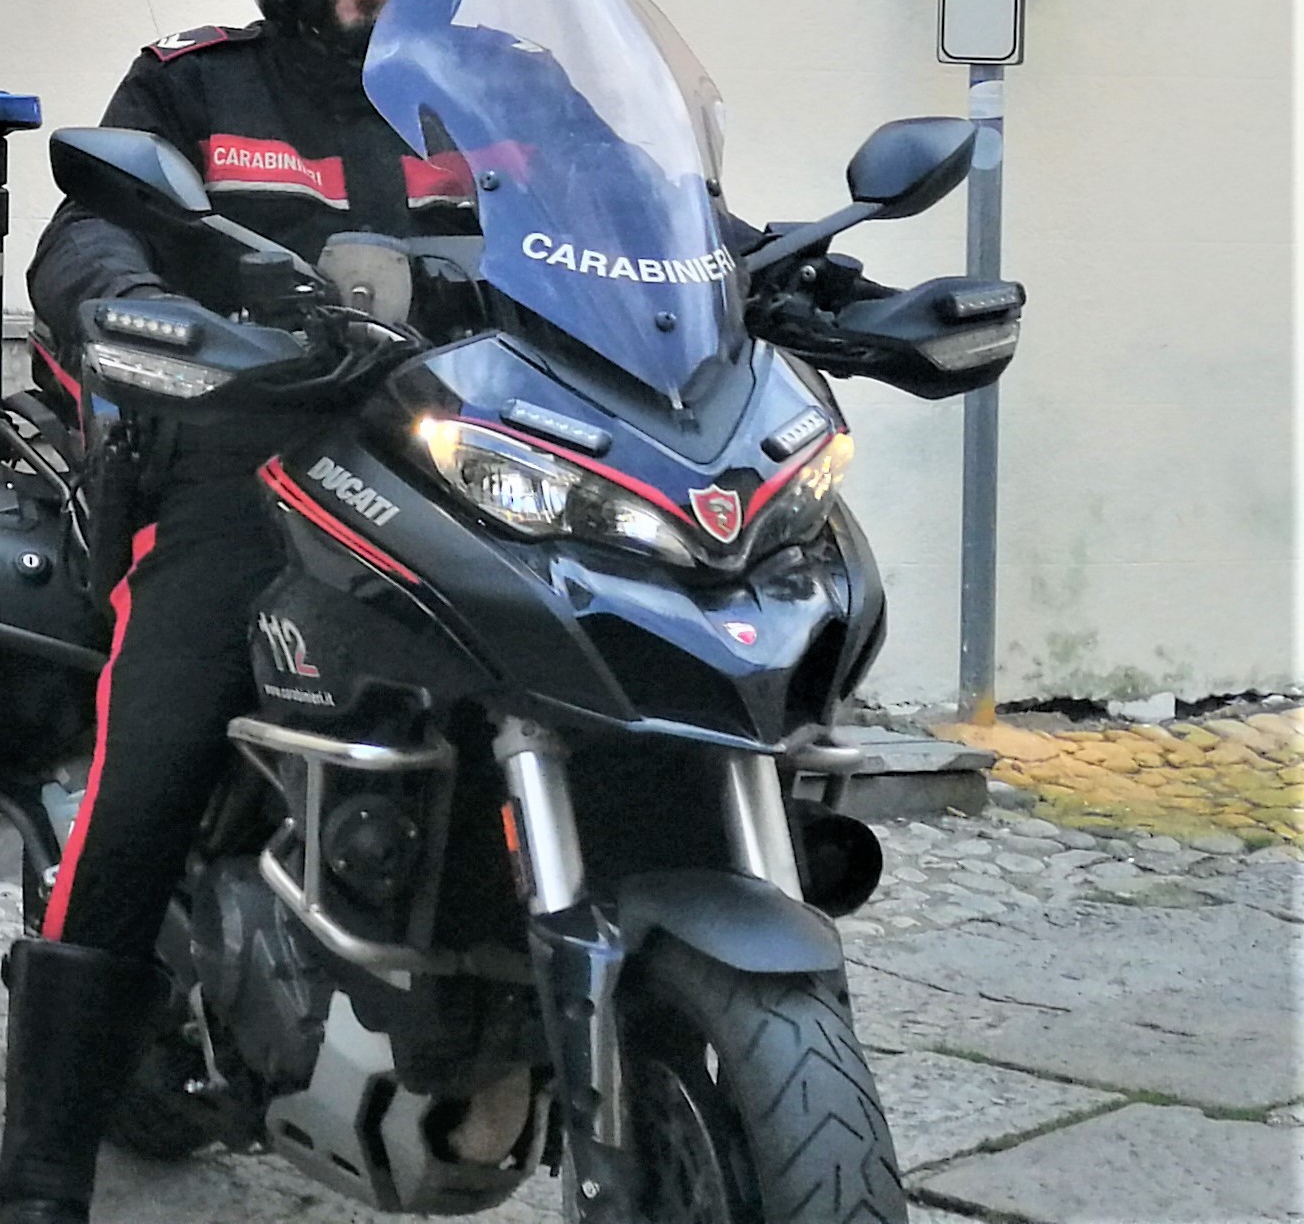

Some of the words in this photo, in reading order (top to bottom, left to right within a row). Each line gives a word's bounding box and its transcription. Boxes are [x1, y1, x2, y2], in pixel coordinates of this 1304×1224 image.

[522, 232, 737, 284] CARABINIERI
[306, 455, 401, 527] DUCATI
[258, 611, 321, 678] 112
